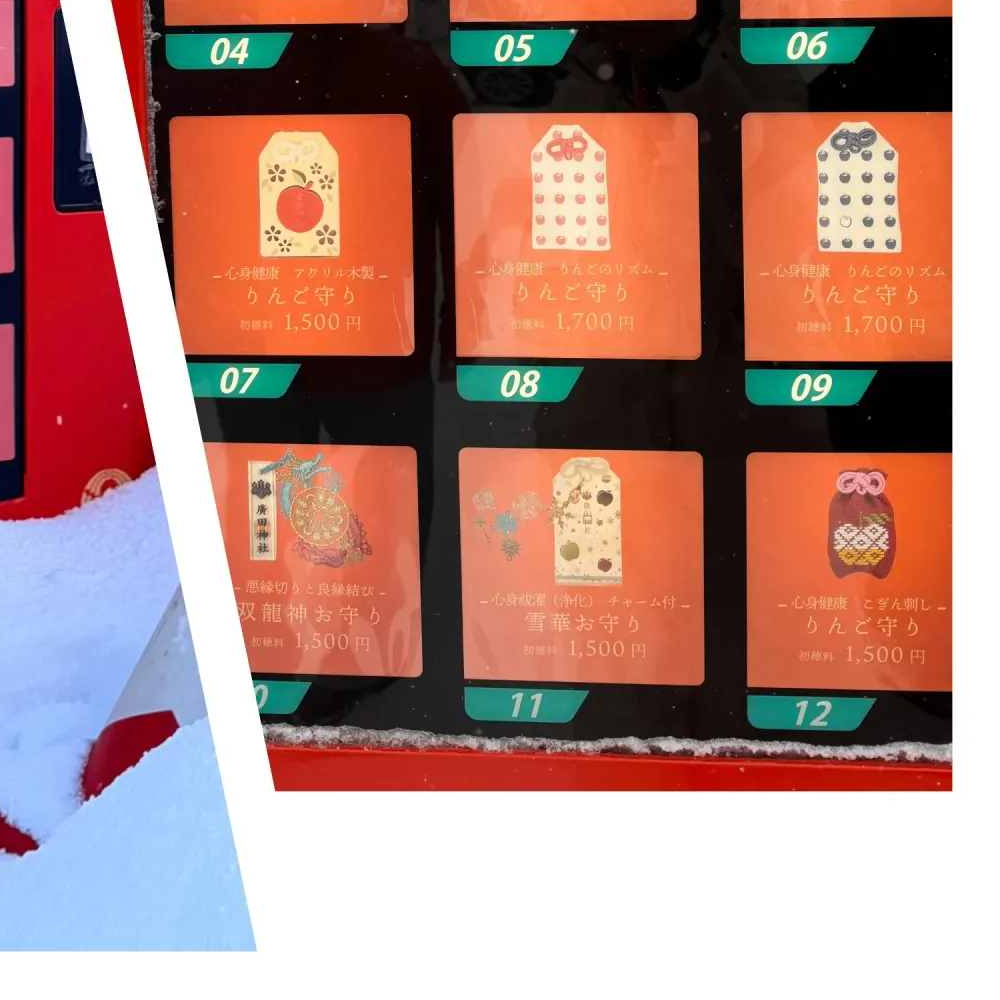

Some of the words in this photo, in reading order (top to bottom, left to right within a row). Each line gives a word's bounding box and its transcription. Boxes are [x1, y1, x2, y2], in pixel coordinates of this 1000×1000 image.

[209, 37, 250, 66] 04
[493, 34, 535, 63] 05
[786, 31, 829, 60] 06
[224, 265, 280, 281] 心身健康
[293, 265, 375, 281] アクリル木製
[488, 261, 544, 276] 心身健康
[559, 262, 654, 276] りんごのリズム
[772, 264, 830, 279] 心身健康
[847, 265, 946, 279] りんごのリズム
[246, 285, 356, 307] りんご守り
[516, 282, 628, 303] りんご守り
[803, 284, 919, 306] りんご守り
[219, 366, 261, 395] 07
[500, 369, 541, 399] 08
[790, 373, 833, 402] 09
[255, 503, 270, 555] 廣田神社
[245, 579, 375, 597] 悪縁切りと良縁結び
[607, 595, 677, 610] チャーム付
[791, 595, 848, 611] 心身健康
[863, 596, 931, 612] こぎん刺し
[524, 611, 640, 634] 雪華お守り
[806, 615, 919, 637] りんご守り
[510, 692, 543, 719] 11
[794, 700, 833, 727] 12
